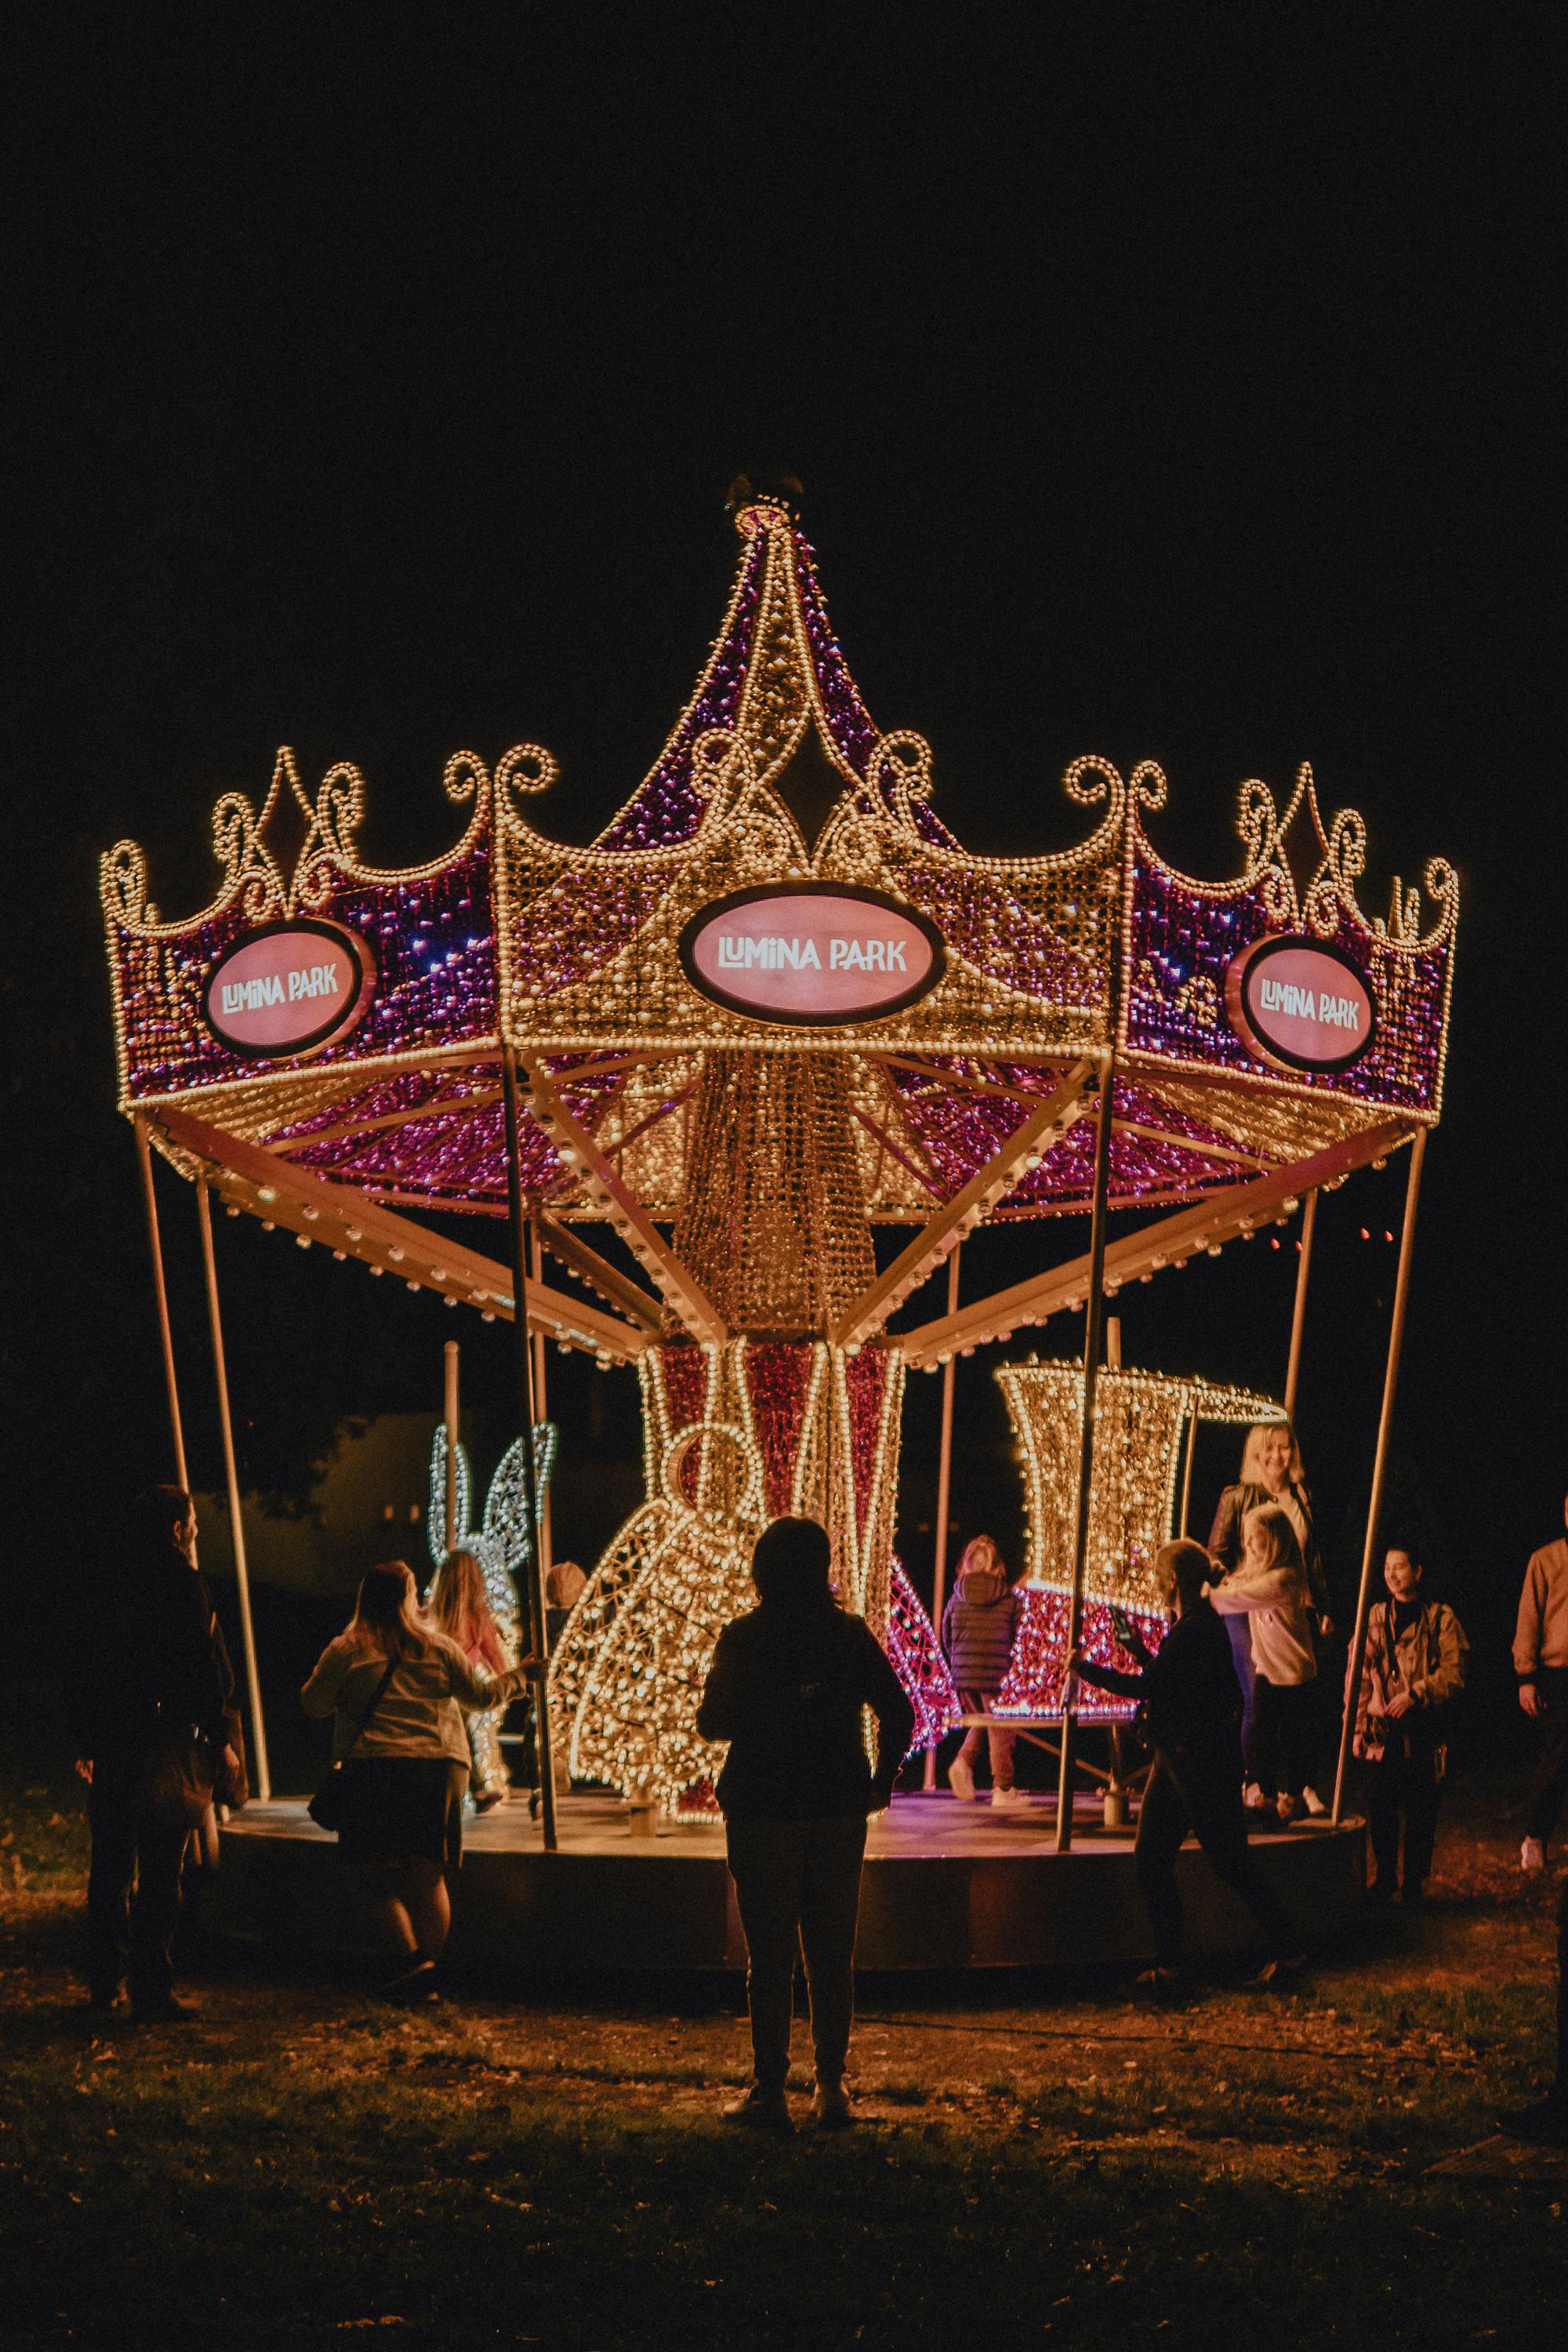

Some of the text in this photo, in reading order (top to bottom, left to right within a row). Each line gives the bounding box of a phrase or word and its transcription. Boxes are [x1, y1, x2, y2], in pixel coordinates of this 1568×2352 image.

[829, 939, 907, 971] PARK
[288, 964, 338, 1001] PARK
[1319, 993, 1359, 1031] PARK
